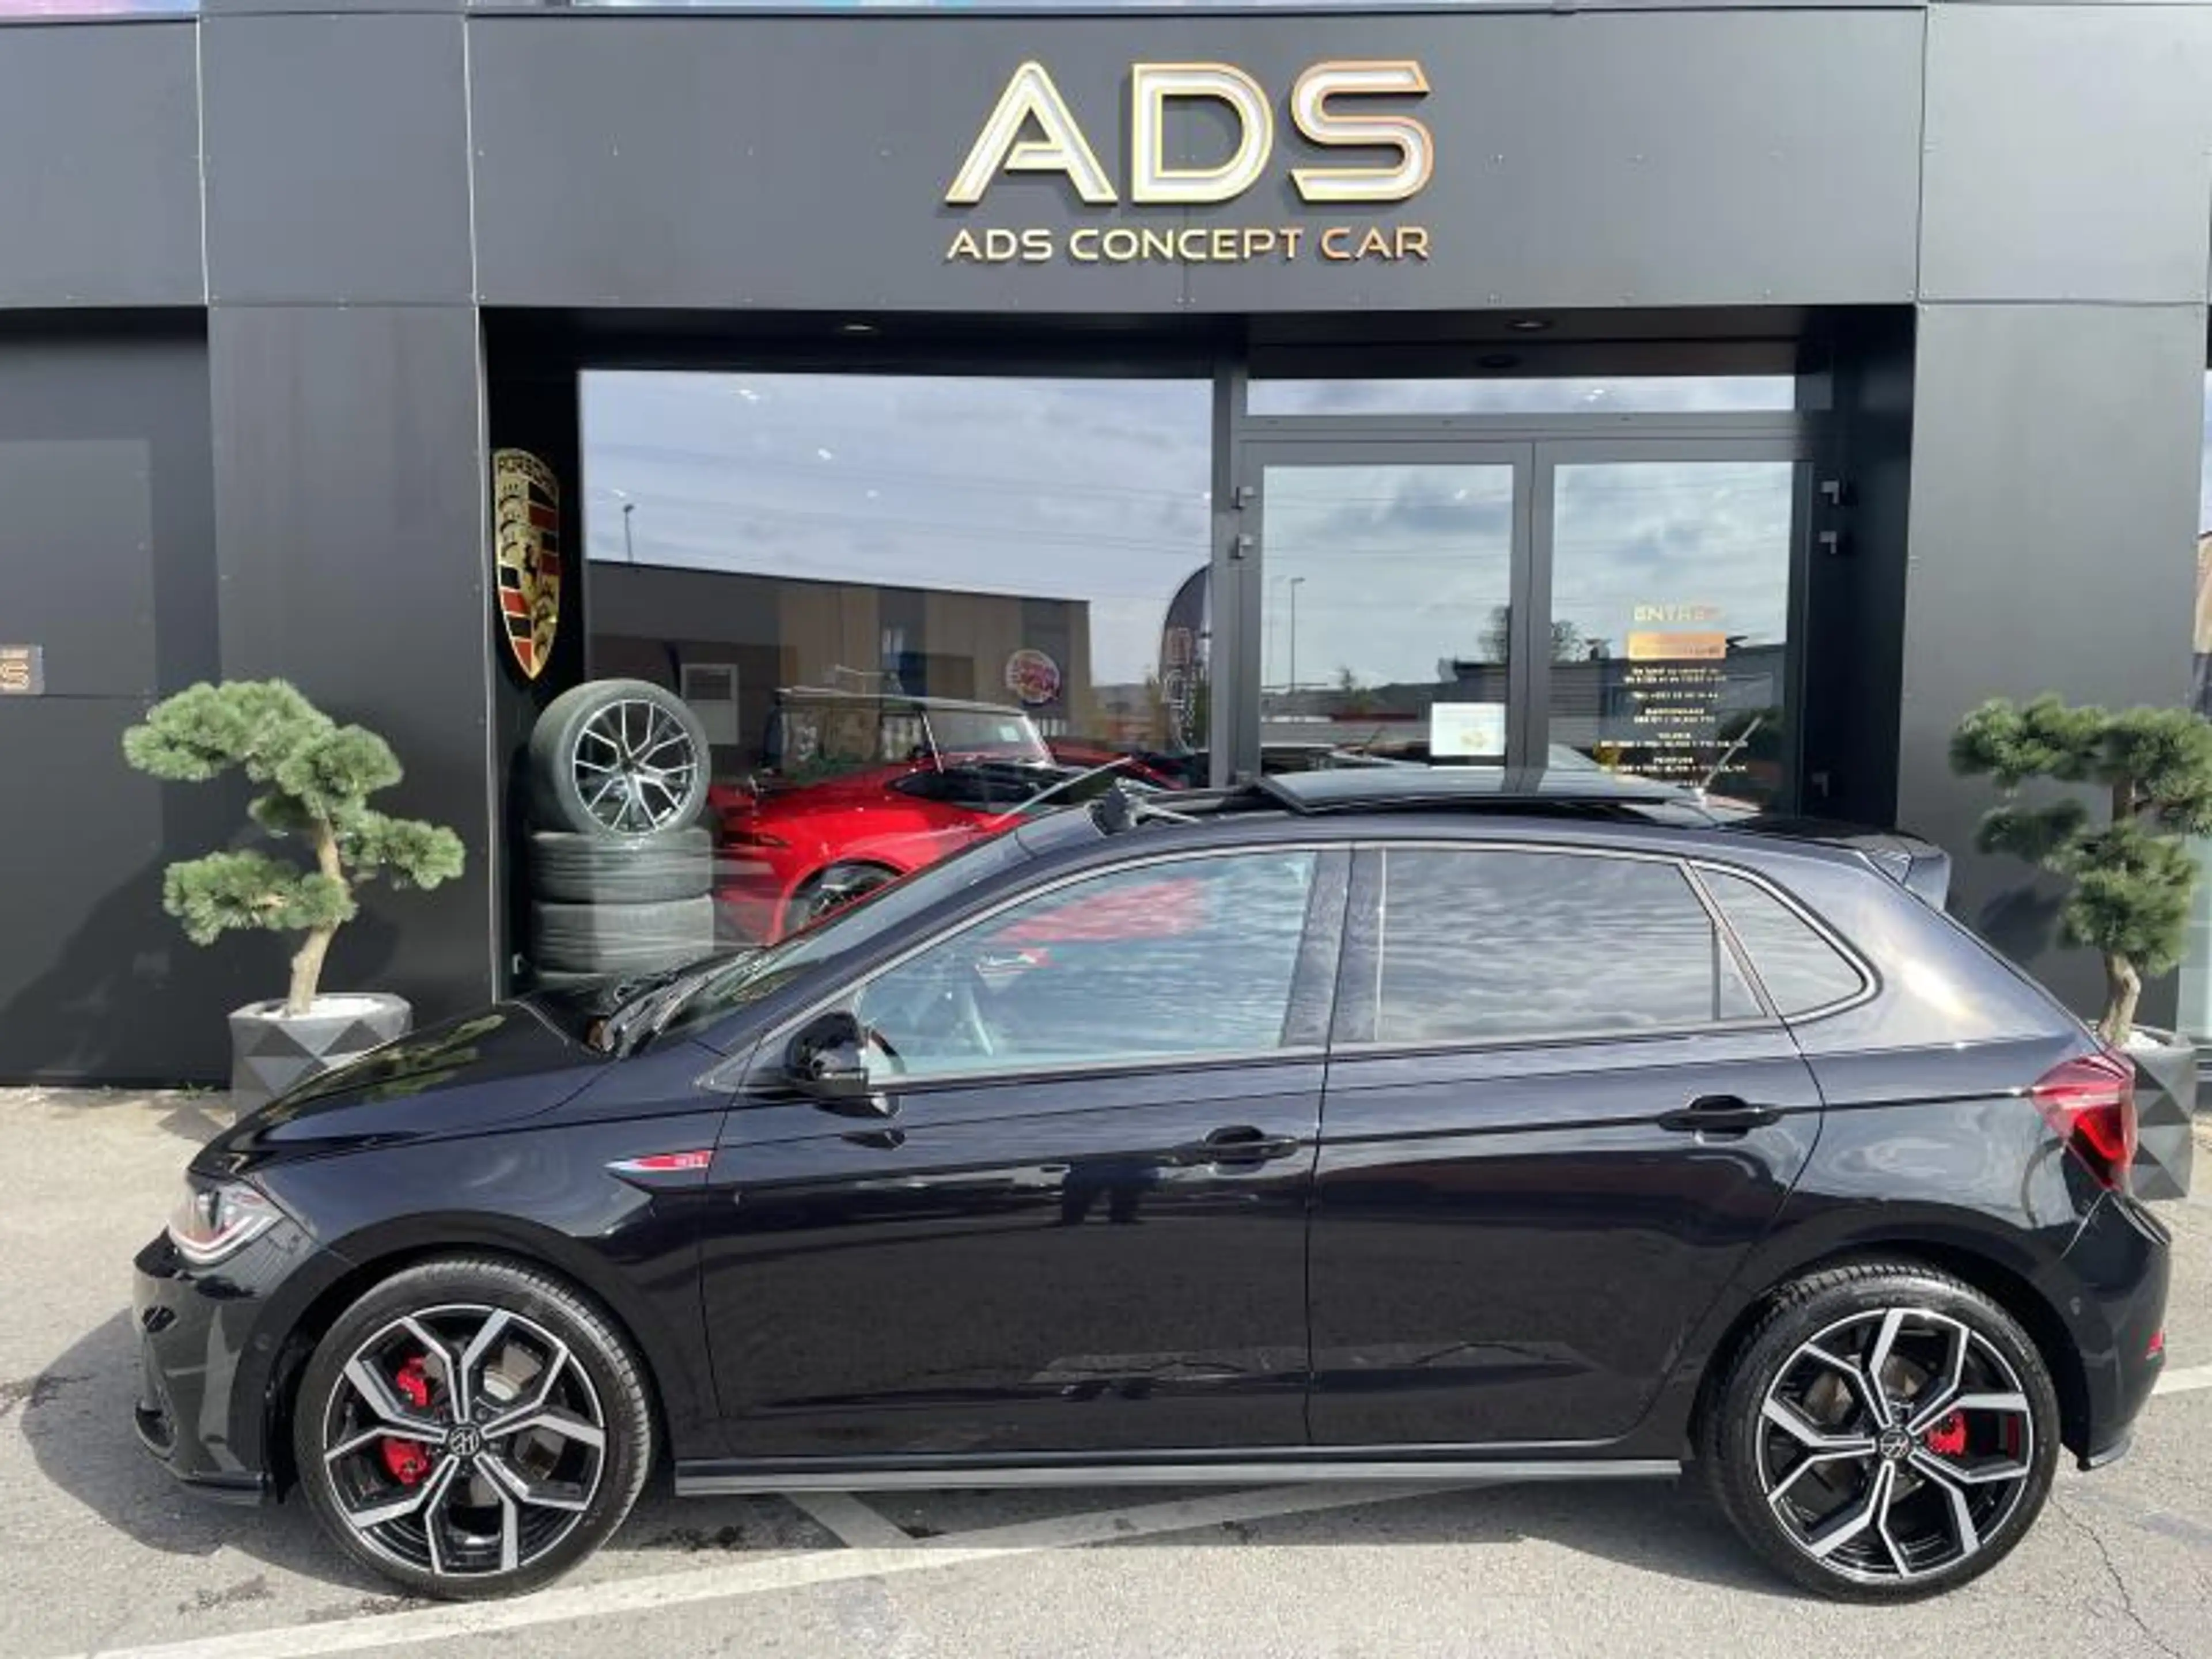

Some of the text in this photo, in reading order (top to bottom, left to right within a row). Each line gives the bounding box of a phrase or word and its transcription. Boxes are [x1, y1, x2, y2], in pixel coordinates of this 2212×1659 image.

[944, 60, 1434, 204] ADS
[947, 226, 1431, 262] ADS CONCEPT CAR
